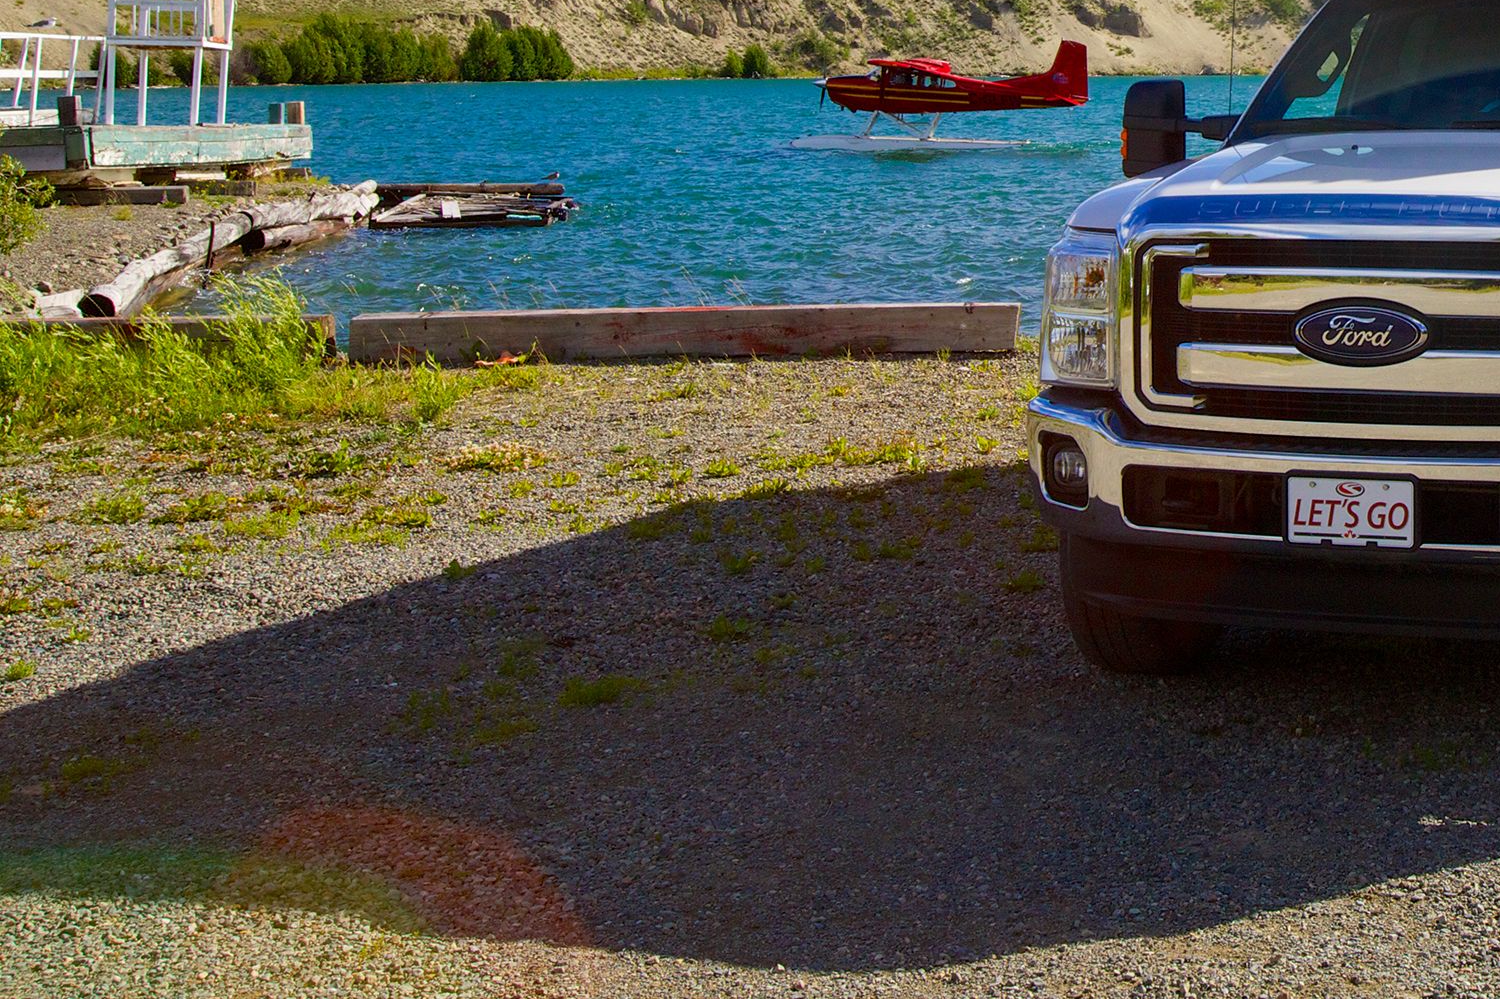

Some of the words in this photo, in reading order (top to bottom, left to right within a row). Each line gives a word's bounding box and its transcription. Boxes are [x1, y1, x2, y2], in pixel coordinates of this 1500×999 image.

[1321, 315, 1393, 347] Ford
[1293, 498, 1360, 528] LET'S
[1366, 501, 1409, 530] GO
